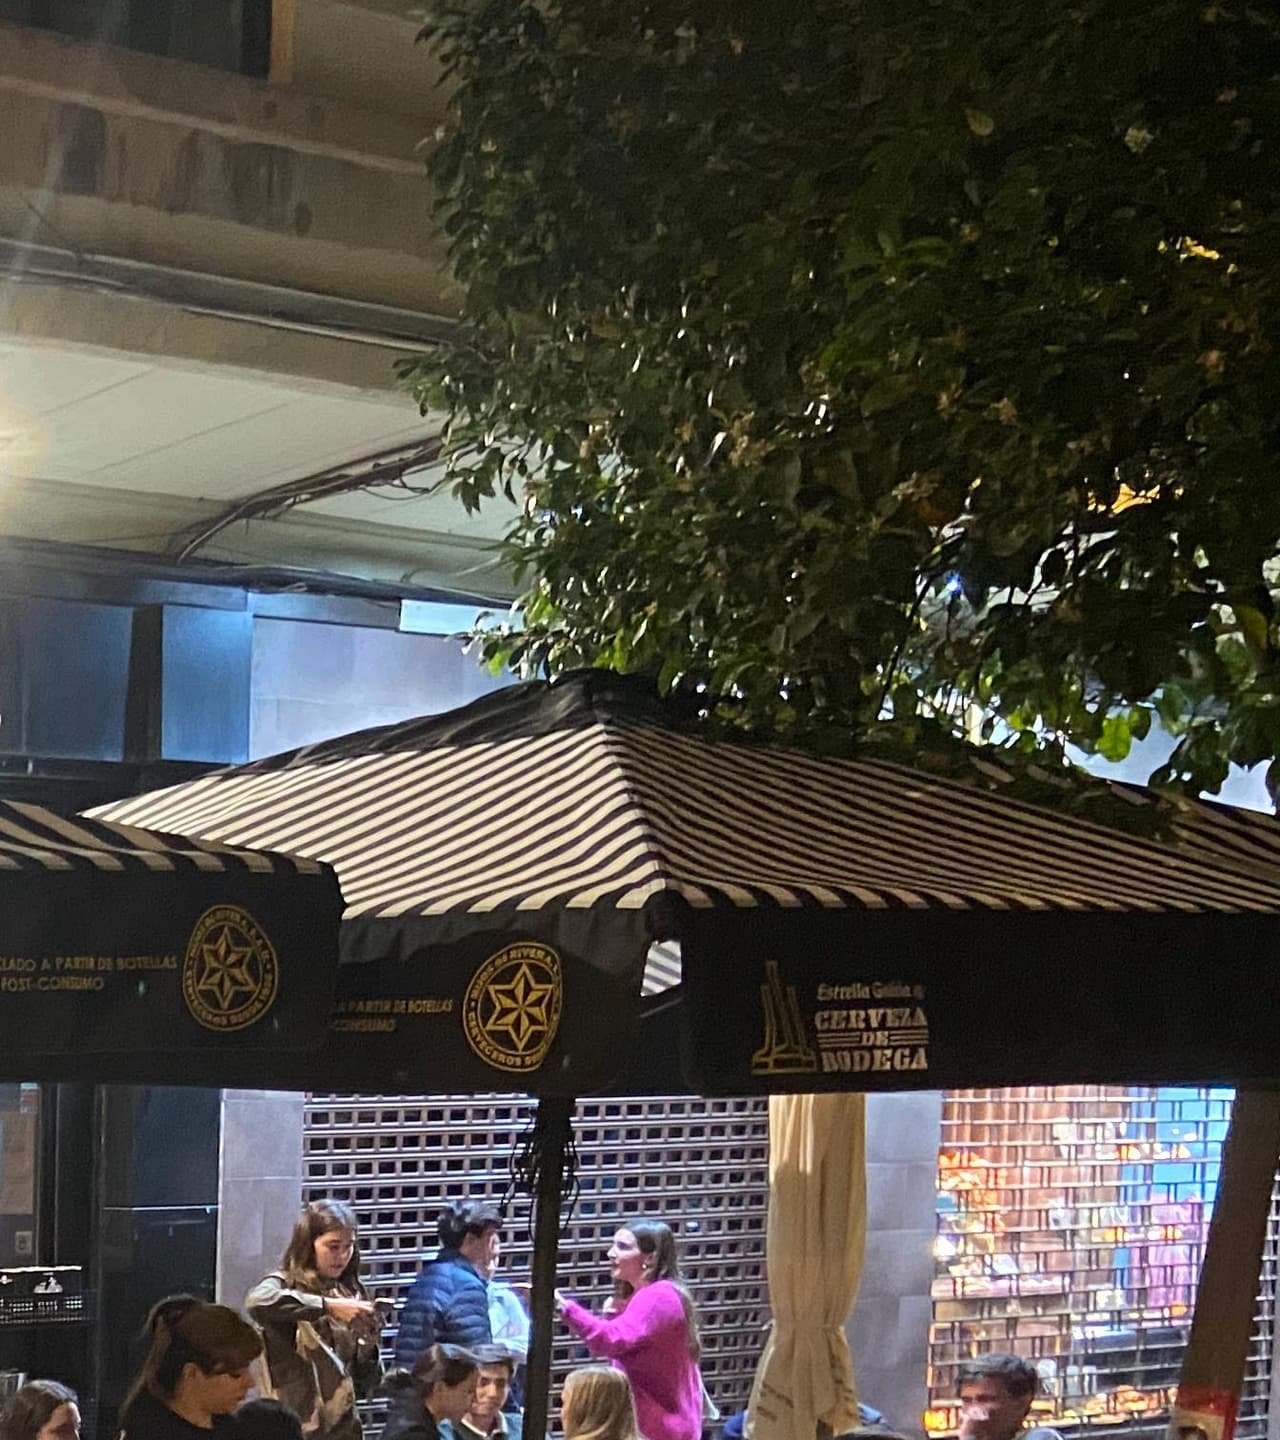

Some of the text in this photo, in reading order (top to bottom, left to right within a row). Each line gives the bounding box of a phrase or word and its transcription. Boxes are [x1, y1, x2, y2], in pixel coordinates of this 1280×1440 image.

[815, 1007, 928, 1030] CERVEZA
[861, 1031, 888, 1046] DE
[820, 1047, 928, 1073] BODEGA
